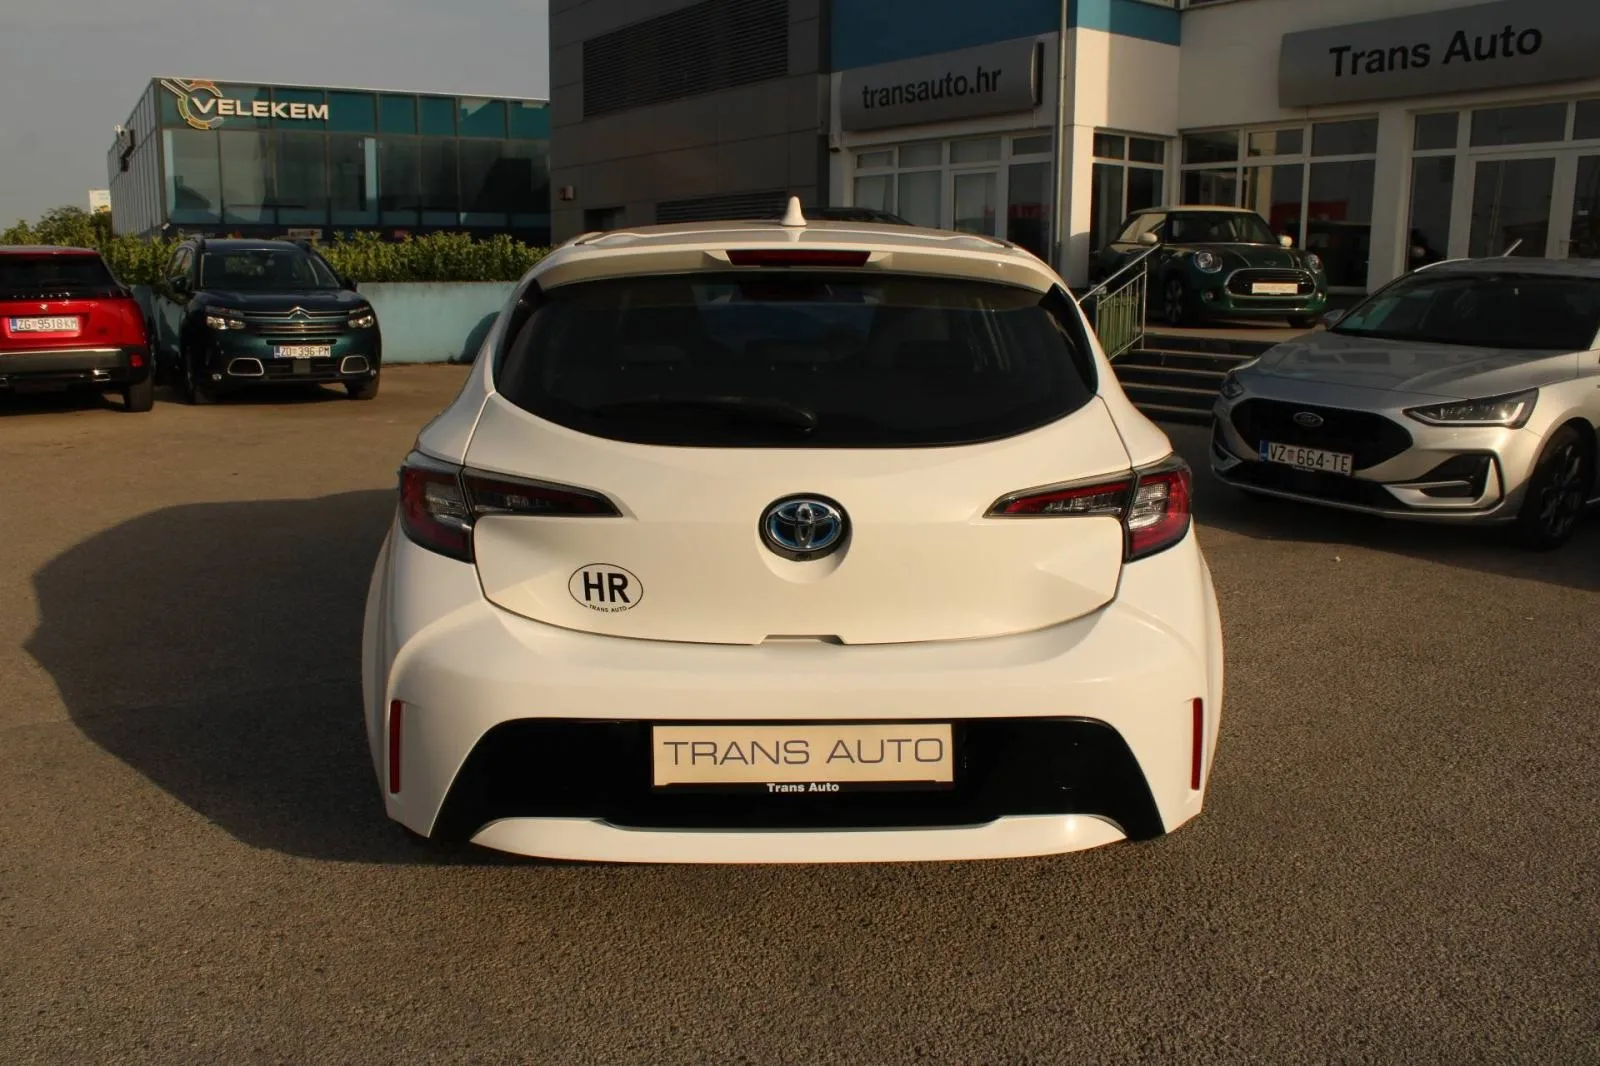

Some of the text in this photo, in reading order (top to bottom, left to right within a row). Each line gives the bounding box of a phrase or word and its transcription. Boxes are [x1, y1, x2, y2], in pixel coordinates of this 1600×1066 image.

[1329, 24, 1544, 77] Trans Auto
[861, 65, 1002, 109] transauto.hr
[191, 96, 329, 120] VELEKEM
[1269, 444, 1350, 473] VZ 664-TE
[583, 571, 631, 603] HR
[589, 604, 628, 613] TRANS AUTO
[663, 738, 943, 765] TRANS AUTO
[766, 782, 840, 793] Trans Auto
